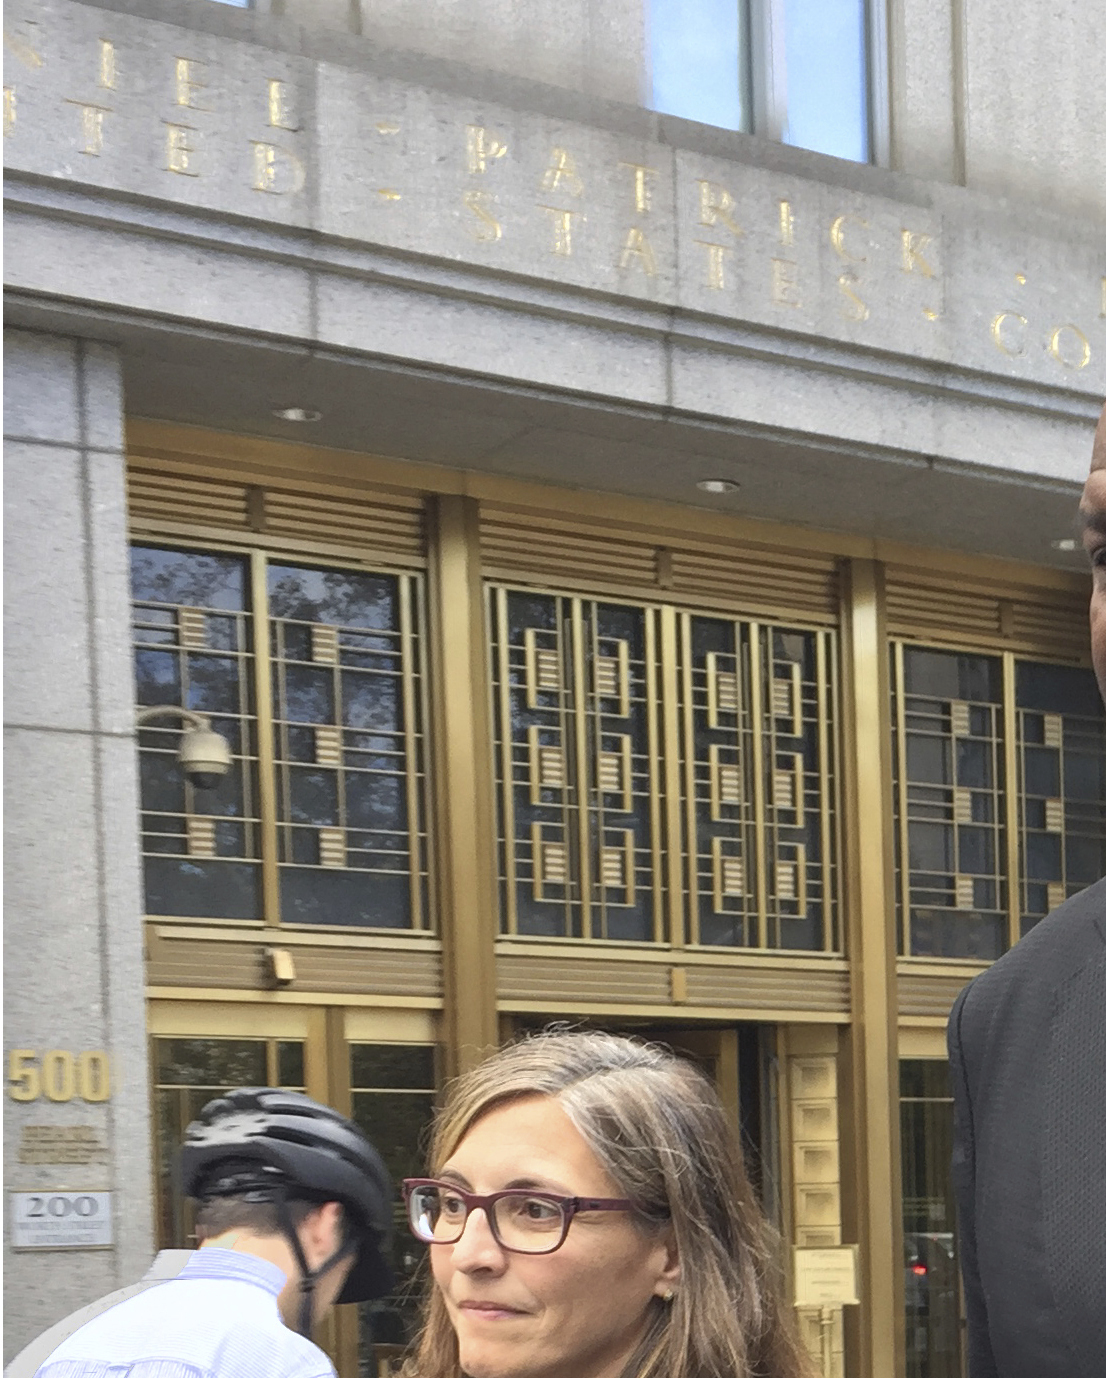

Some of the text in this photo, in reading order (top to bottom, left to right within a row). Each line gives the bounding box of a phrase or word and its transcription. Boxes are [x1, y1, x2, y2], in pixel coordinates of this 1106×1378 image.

[465, 123, 936, 280] PATRICK
[462, 188, 870, 322] STATES
[8, 1050, 110, 1102] 500
[26, 1196, 99, 1217] 200
